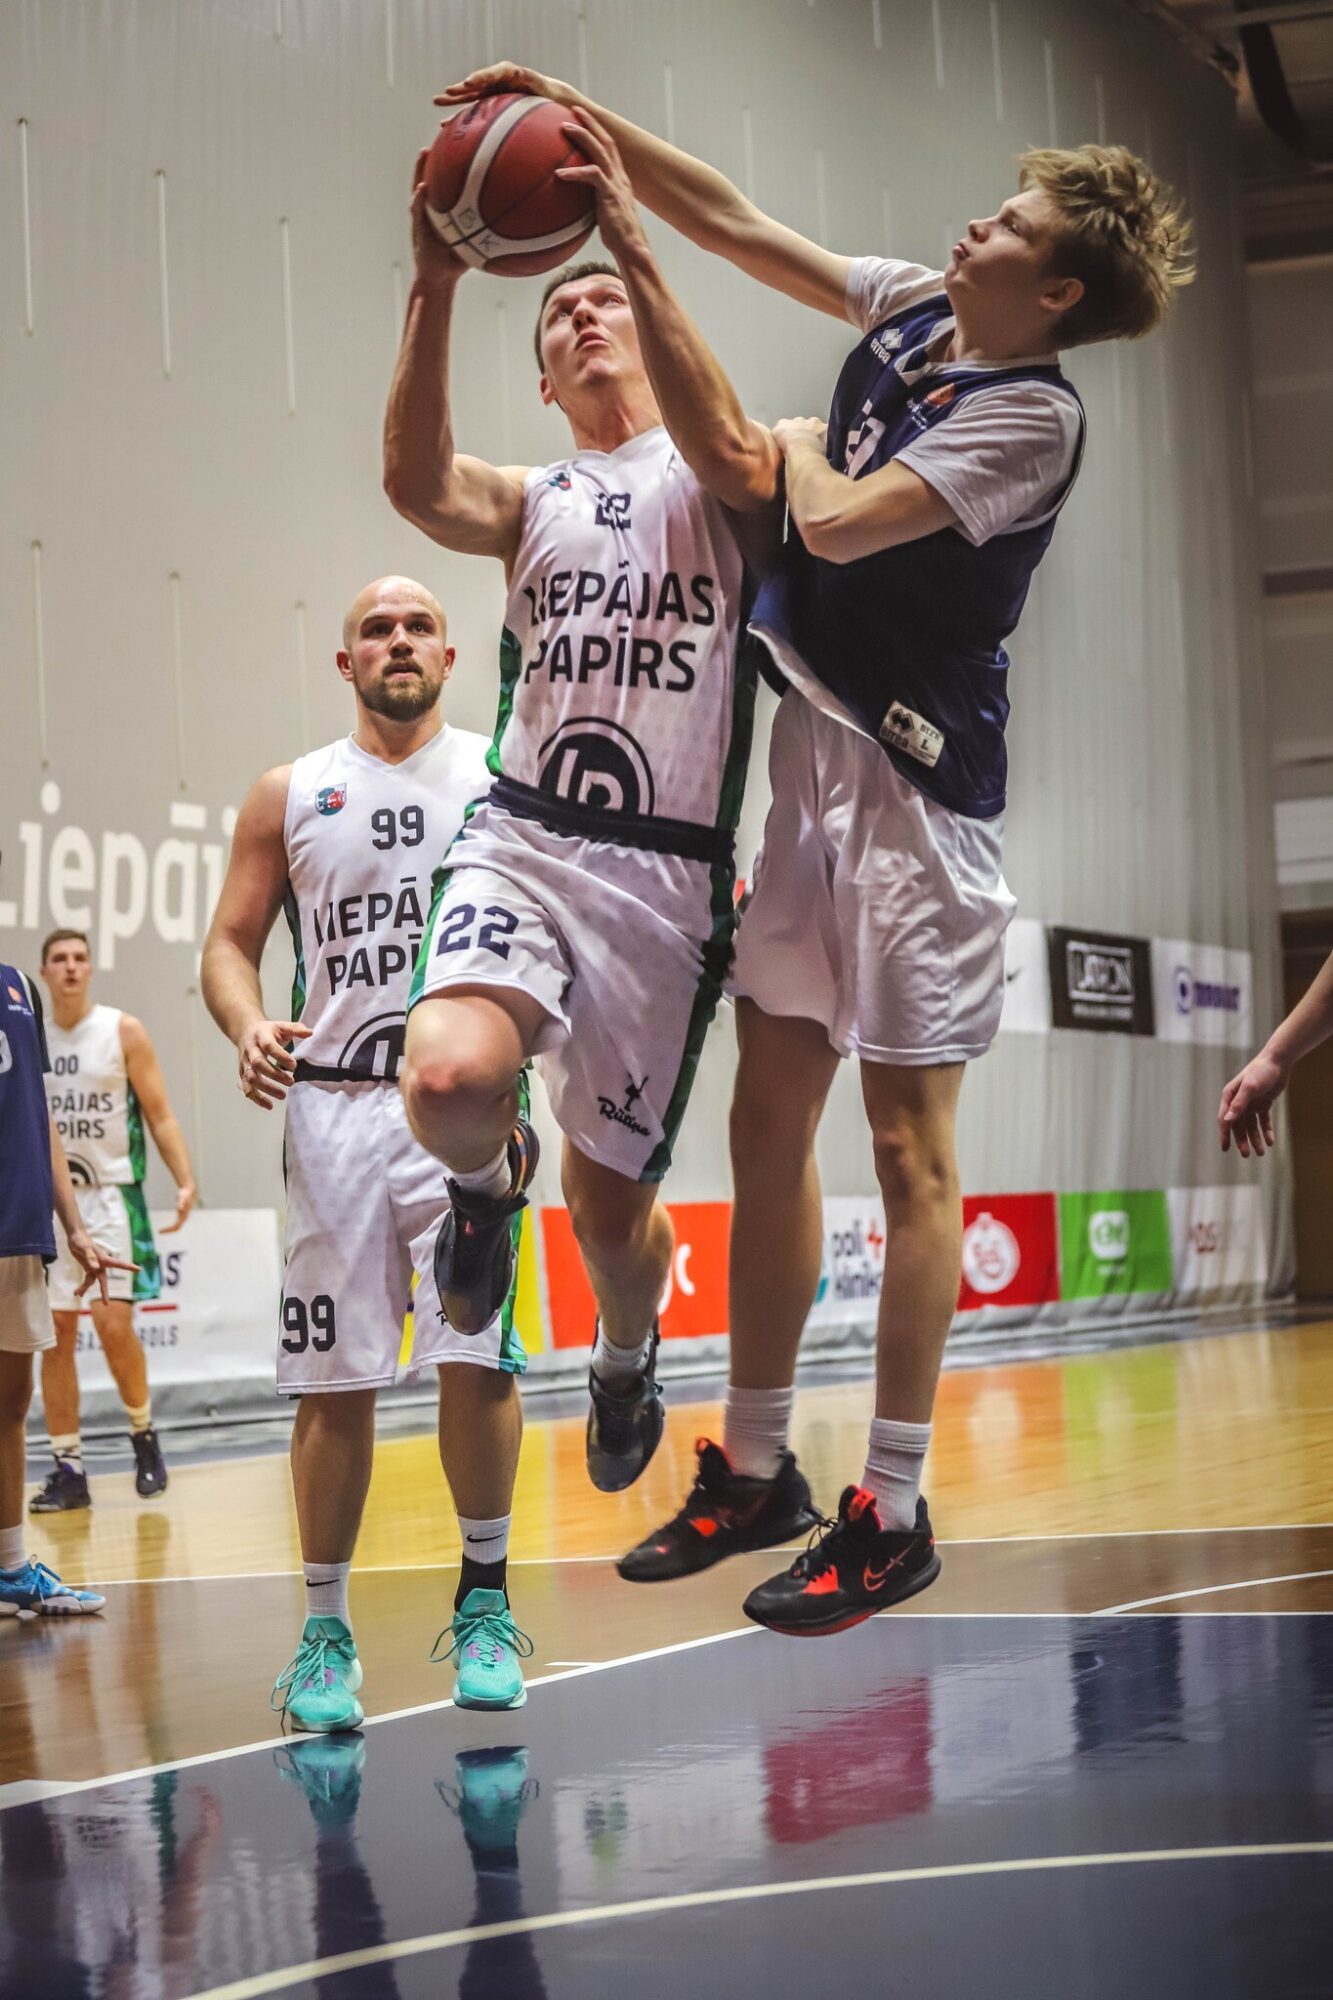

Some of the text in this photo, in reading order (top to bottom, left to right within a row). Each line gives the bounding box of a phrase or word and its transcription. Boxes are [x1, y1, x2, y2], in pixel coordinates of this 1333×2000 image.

[524, 626, 697, 692] PAPĪRS
[371, 804, 425, 850] 99
[0, 781, 237, 977] iepāj
[314, 876, 436, 948] LIEPĀ
[436, 902, 520, 961] 22
[54, 1053, 79, 1076] 00
[281, 1294, 336, 1354] 99
